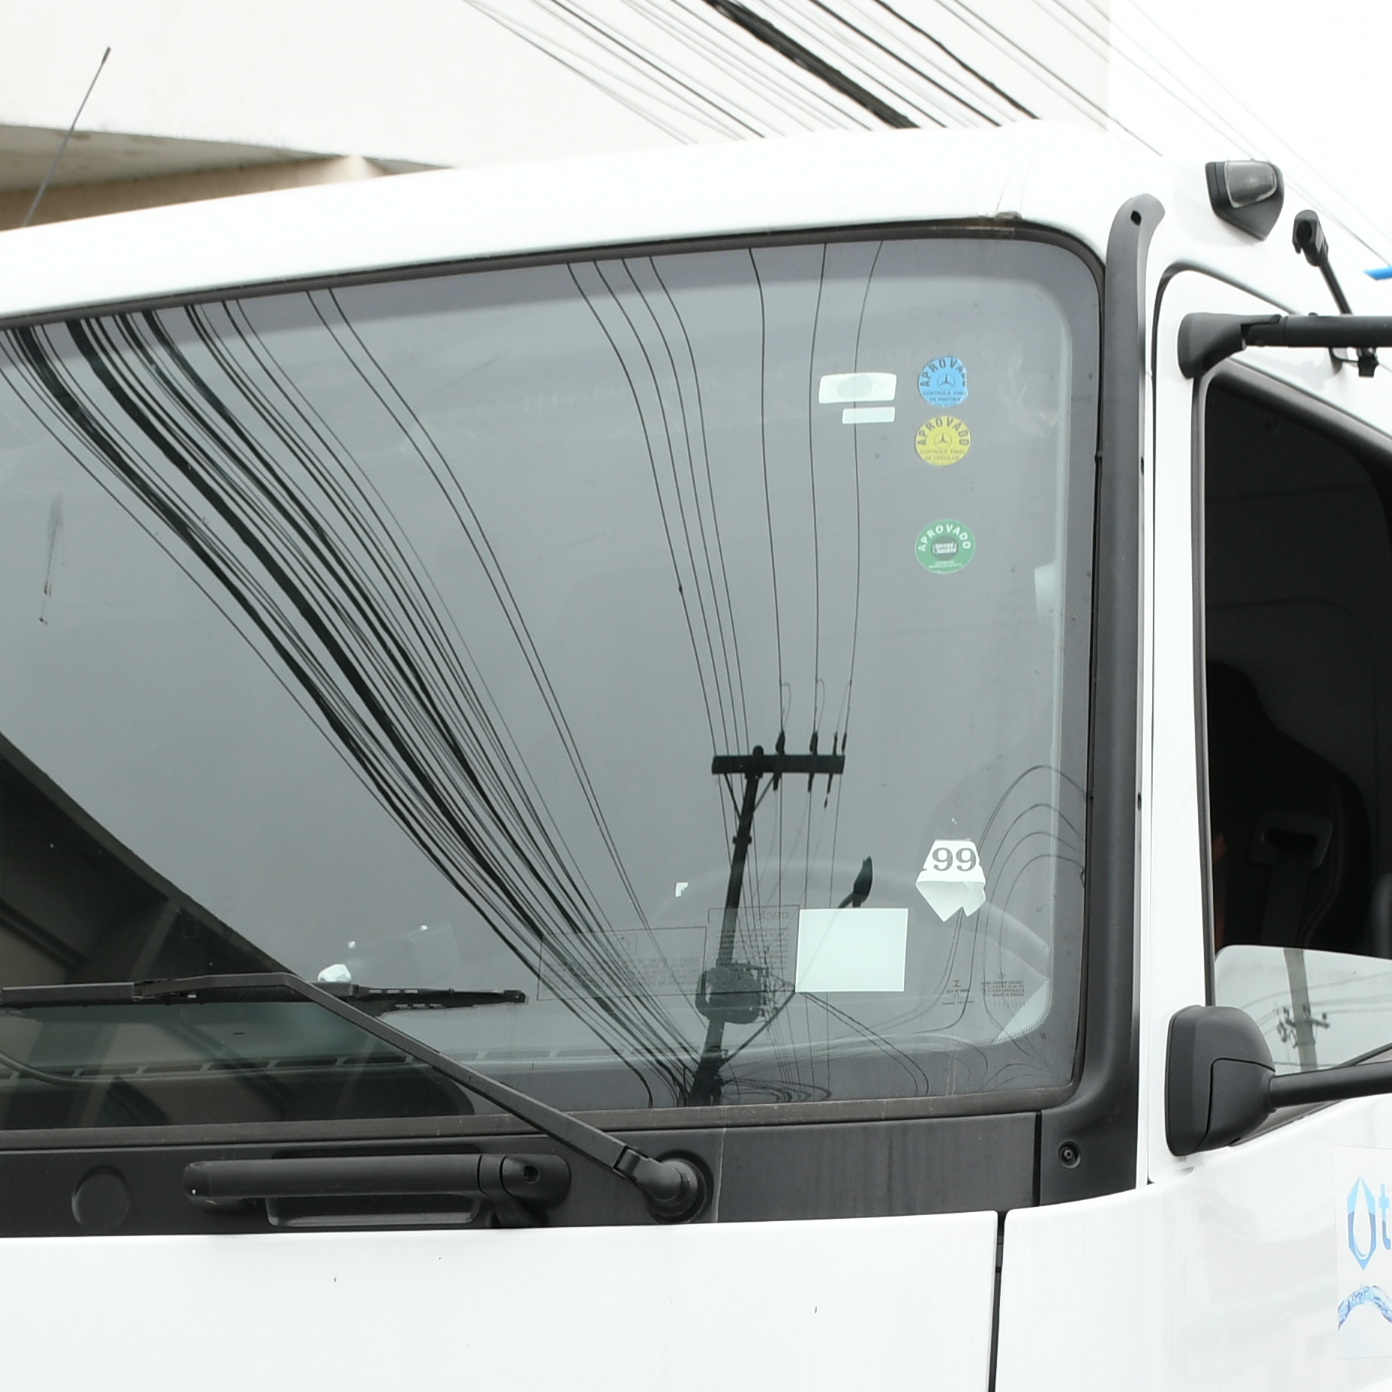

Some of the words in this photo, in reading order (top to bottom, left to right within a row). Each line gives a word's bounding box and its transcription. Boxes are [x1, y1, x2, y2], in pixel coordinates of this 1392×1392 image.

[917, 417, 969, 446] APROVADO
[917, 523, 972, 553] APROVADO
[931, 847, 977, 872] 99
